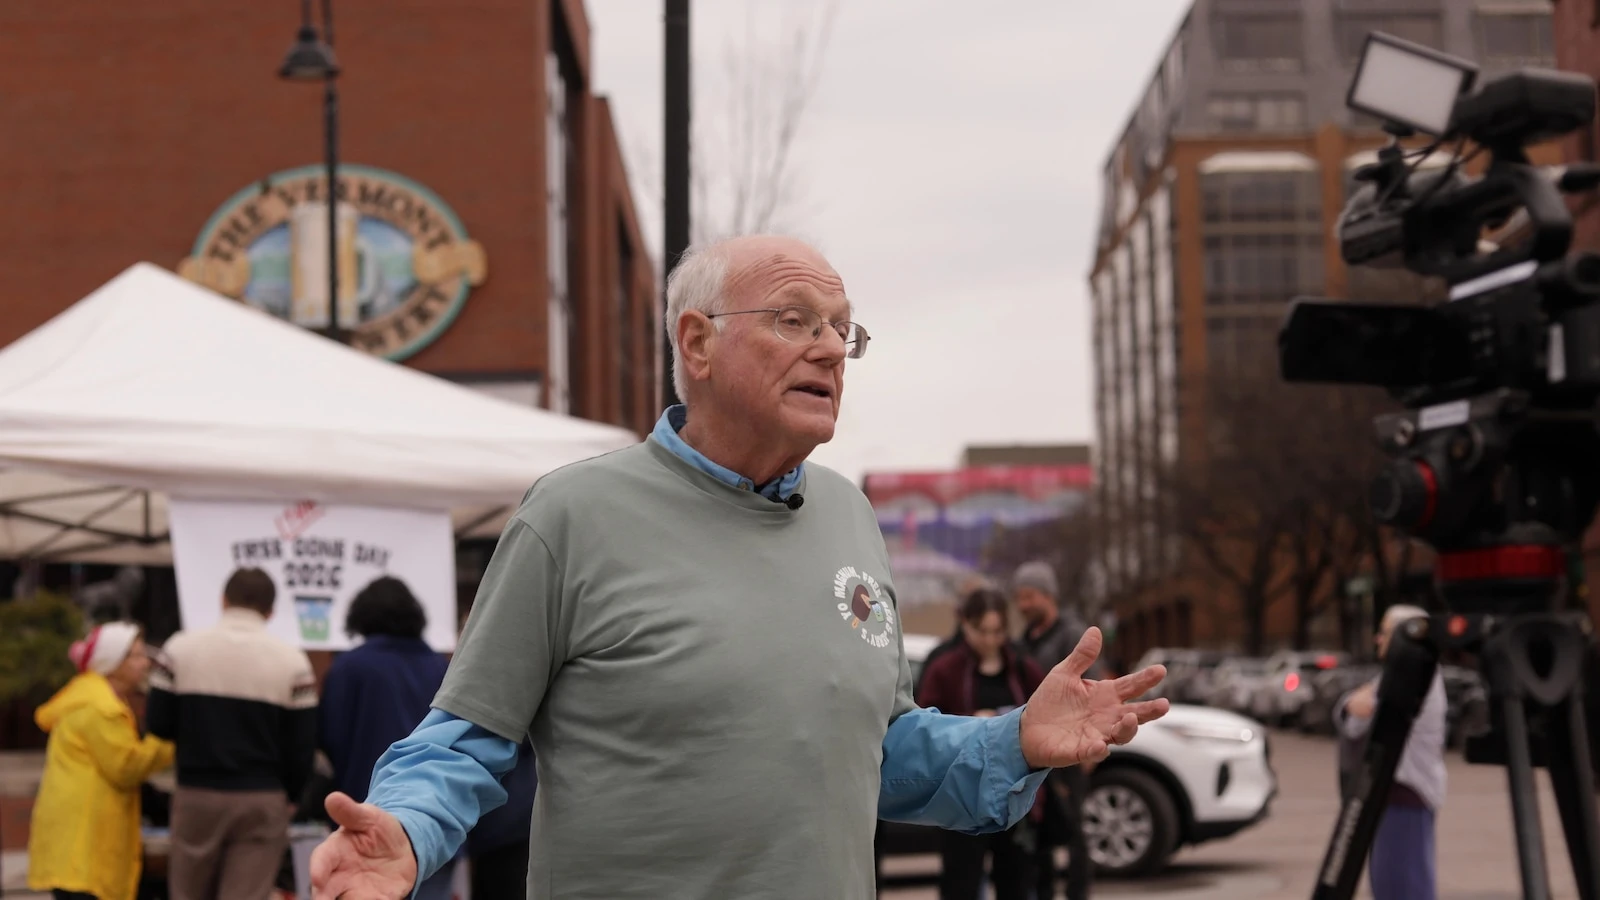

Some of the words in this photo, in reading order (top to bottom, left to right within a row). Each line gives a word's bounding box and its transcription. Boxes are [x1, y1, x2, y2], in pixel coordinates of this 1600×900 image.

[209, 201, 264, 263] THE
[358, 282, 448, 351] WERY
[232, 537, 283, 561] FREE
[284, 563, 343, 589] 2026
[837, 602, 852, 620] YO
[862, 571, 882, 599] FREE
[880, 601, 893, 624] BEN
